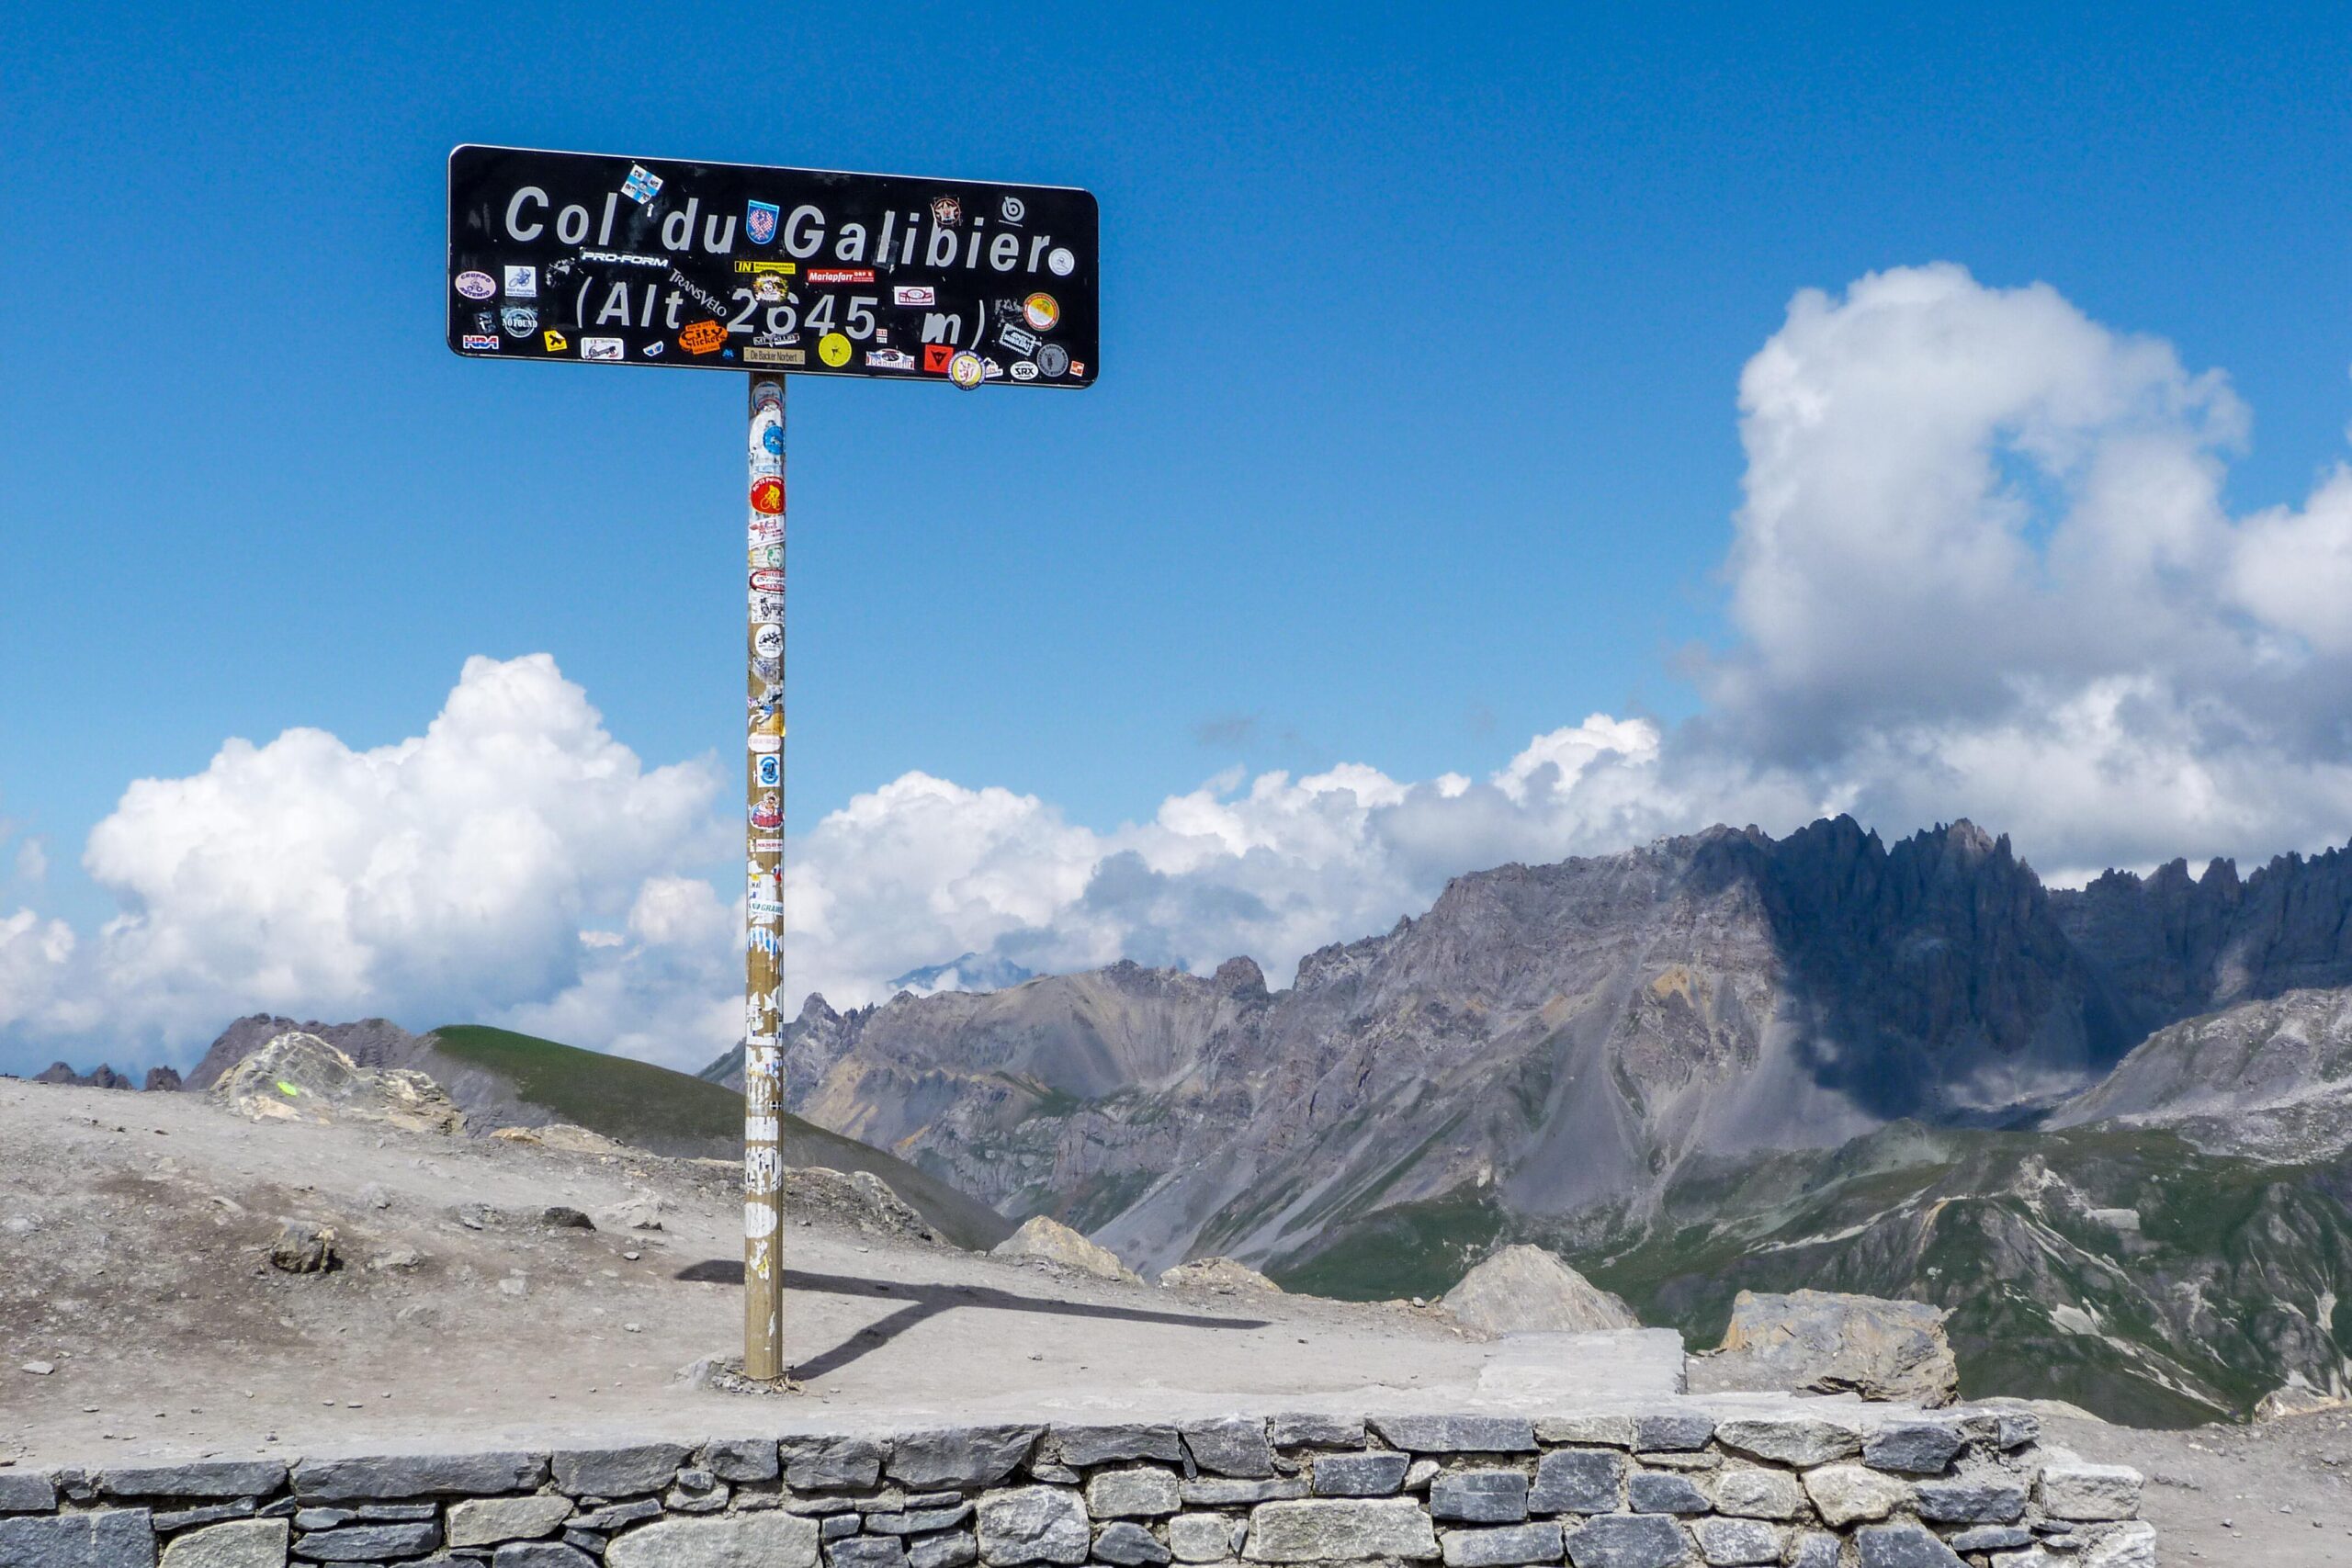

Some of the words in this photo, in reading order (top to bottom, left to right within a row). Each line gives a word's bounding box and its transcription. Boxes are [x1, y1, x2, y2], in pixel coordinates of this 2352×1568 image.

[505, 186, 617, 245] Col
[662, 197, 737, 253] du
[784, 204, 1050, 272] Galibier
[582, 251, 669, 267] PRO-FORM
[738, 261, 752, 272] IN
[460, 273, 491, 284] GRUPPO
[808, 272, 853, 282] Mariapfarr
[576, 276, 684, 329] (Alt
[727, 288, 878, 340] 2645
[681, 327, 723, 341] City
[750, 351, 759, 359] De
[760, 351, 776, 360] Backer
[776, 352, 797, 361] Norbert
[1014, 367, 1035, 376] SRX
